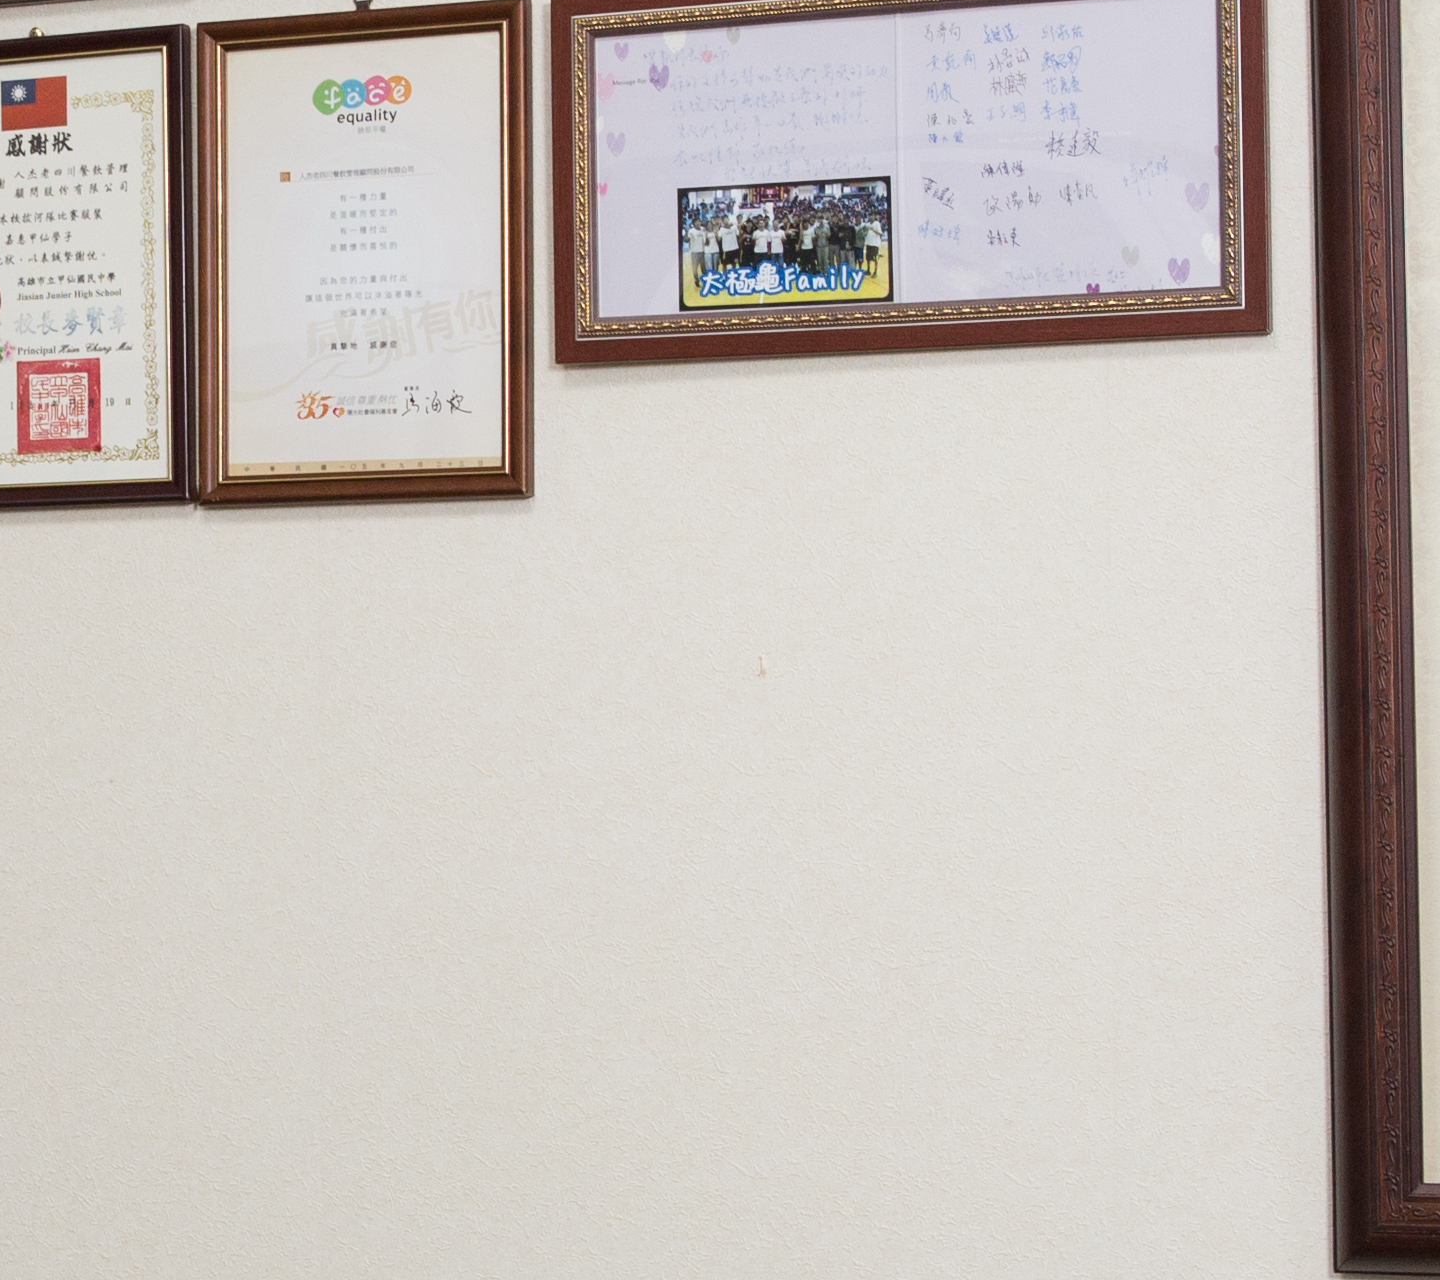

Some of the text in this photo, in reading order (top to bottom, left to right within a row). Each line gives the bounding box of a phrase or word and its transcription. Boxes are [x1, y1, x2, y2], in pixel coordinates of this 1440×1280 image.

[336, 109, 397, 125] equality
[6, 132, 73, 157] 感謝狀
[14, 163, 129, 180] 人杰老四川餐飲管理
[14, 180, 128, 199] 顧問股份有限公司
[340, 192, 387, 203] 有一種力量
[17, 272, 116, 287] 高雄市立甲仙國民中學
[700, 262, 866, 296] 太極龜Family
[46, 288, 122, 299] Junior High School
[17, 346, 57, 356] Principal
